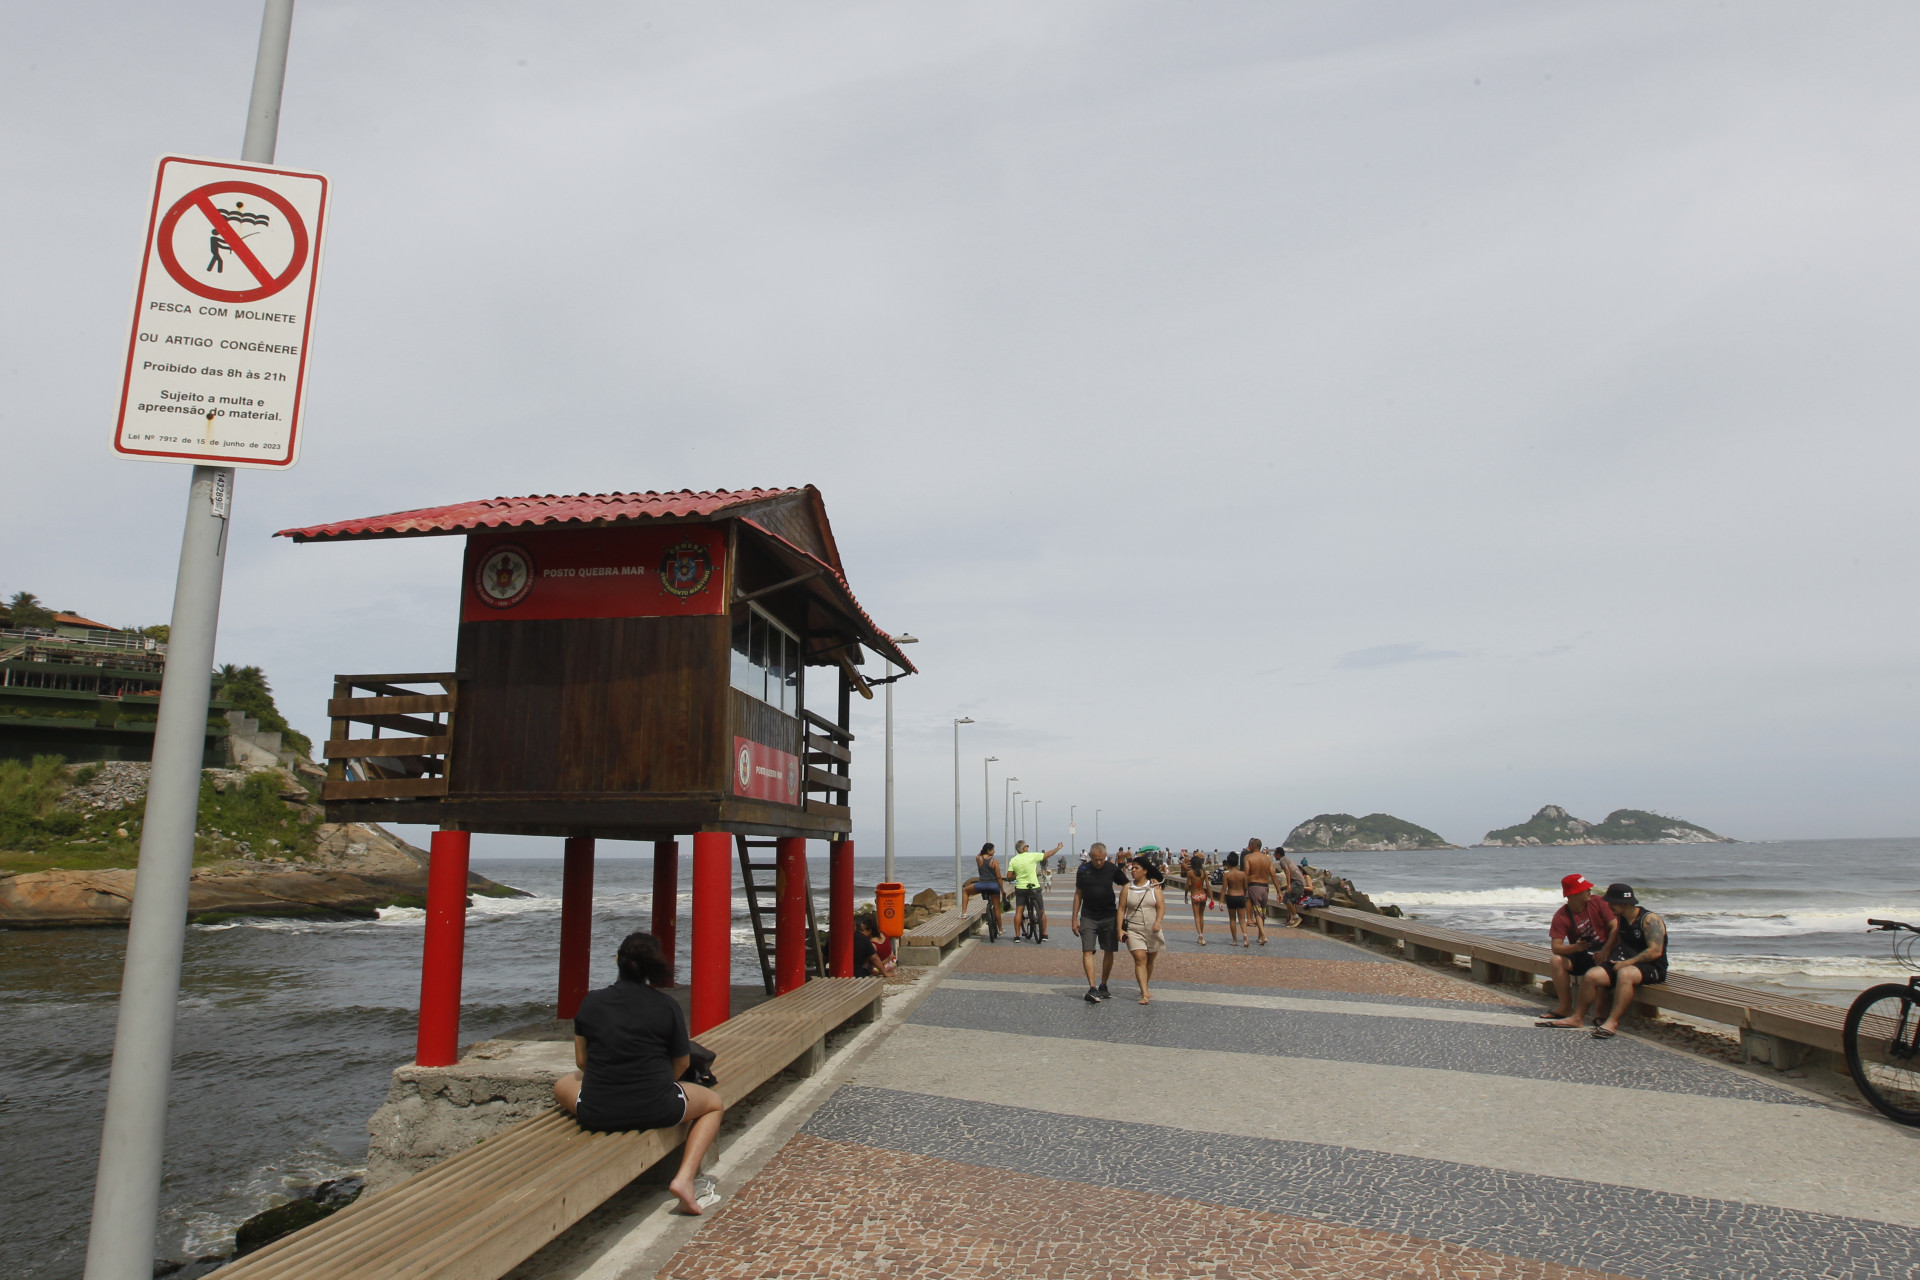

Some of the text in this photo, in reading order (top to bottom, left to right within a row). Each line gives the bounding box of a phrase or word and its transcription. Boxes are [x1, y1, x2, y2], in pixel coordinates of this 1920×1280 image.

[150, 301, 296, 324] PESCA COM MOLINETE
[139, 332, 298, 355] OU ARTIGO CONGÊNERE
[143, 361, 286, 382] Proibido das 8h às 21h
[160, 390, 264, 407] Sujeito a multa e
[138, 403, 282, 422] apreensão do material.
[223, 440, 245, 448] junho
[544, 566, 645, 578] POSTO QUEBRA MAR
